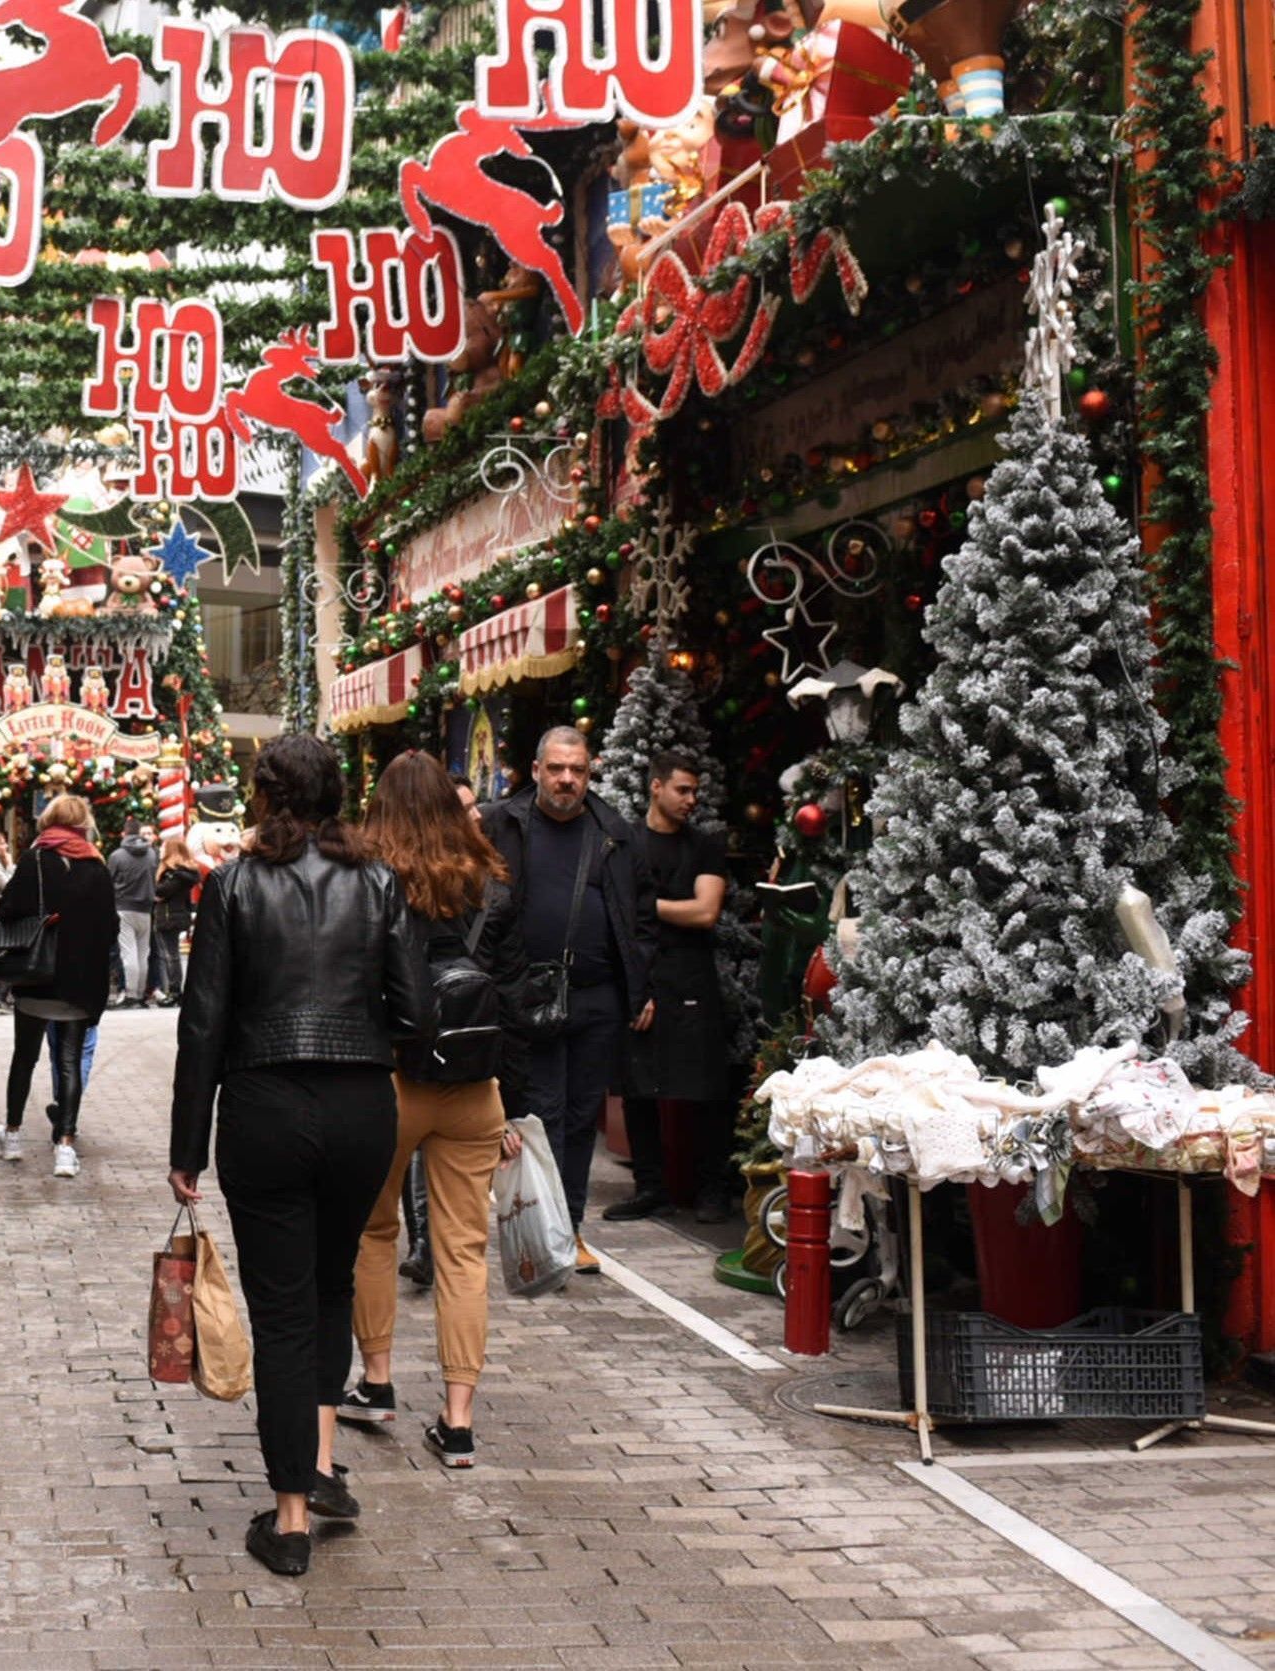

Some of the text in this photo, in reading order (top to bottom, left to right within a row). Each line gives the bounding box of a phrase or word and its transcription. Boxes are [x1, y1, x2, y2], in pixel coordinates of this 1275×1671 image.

[148, 17, 352, 210] HO
[475, 0, 704, 127] HO
[311, 226, 466, 363] HO
[82, 297, 224, 422] HO
[128, 416, 240, 502] HO
